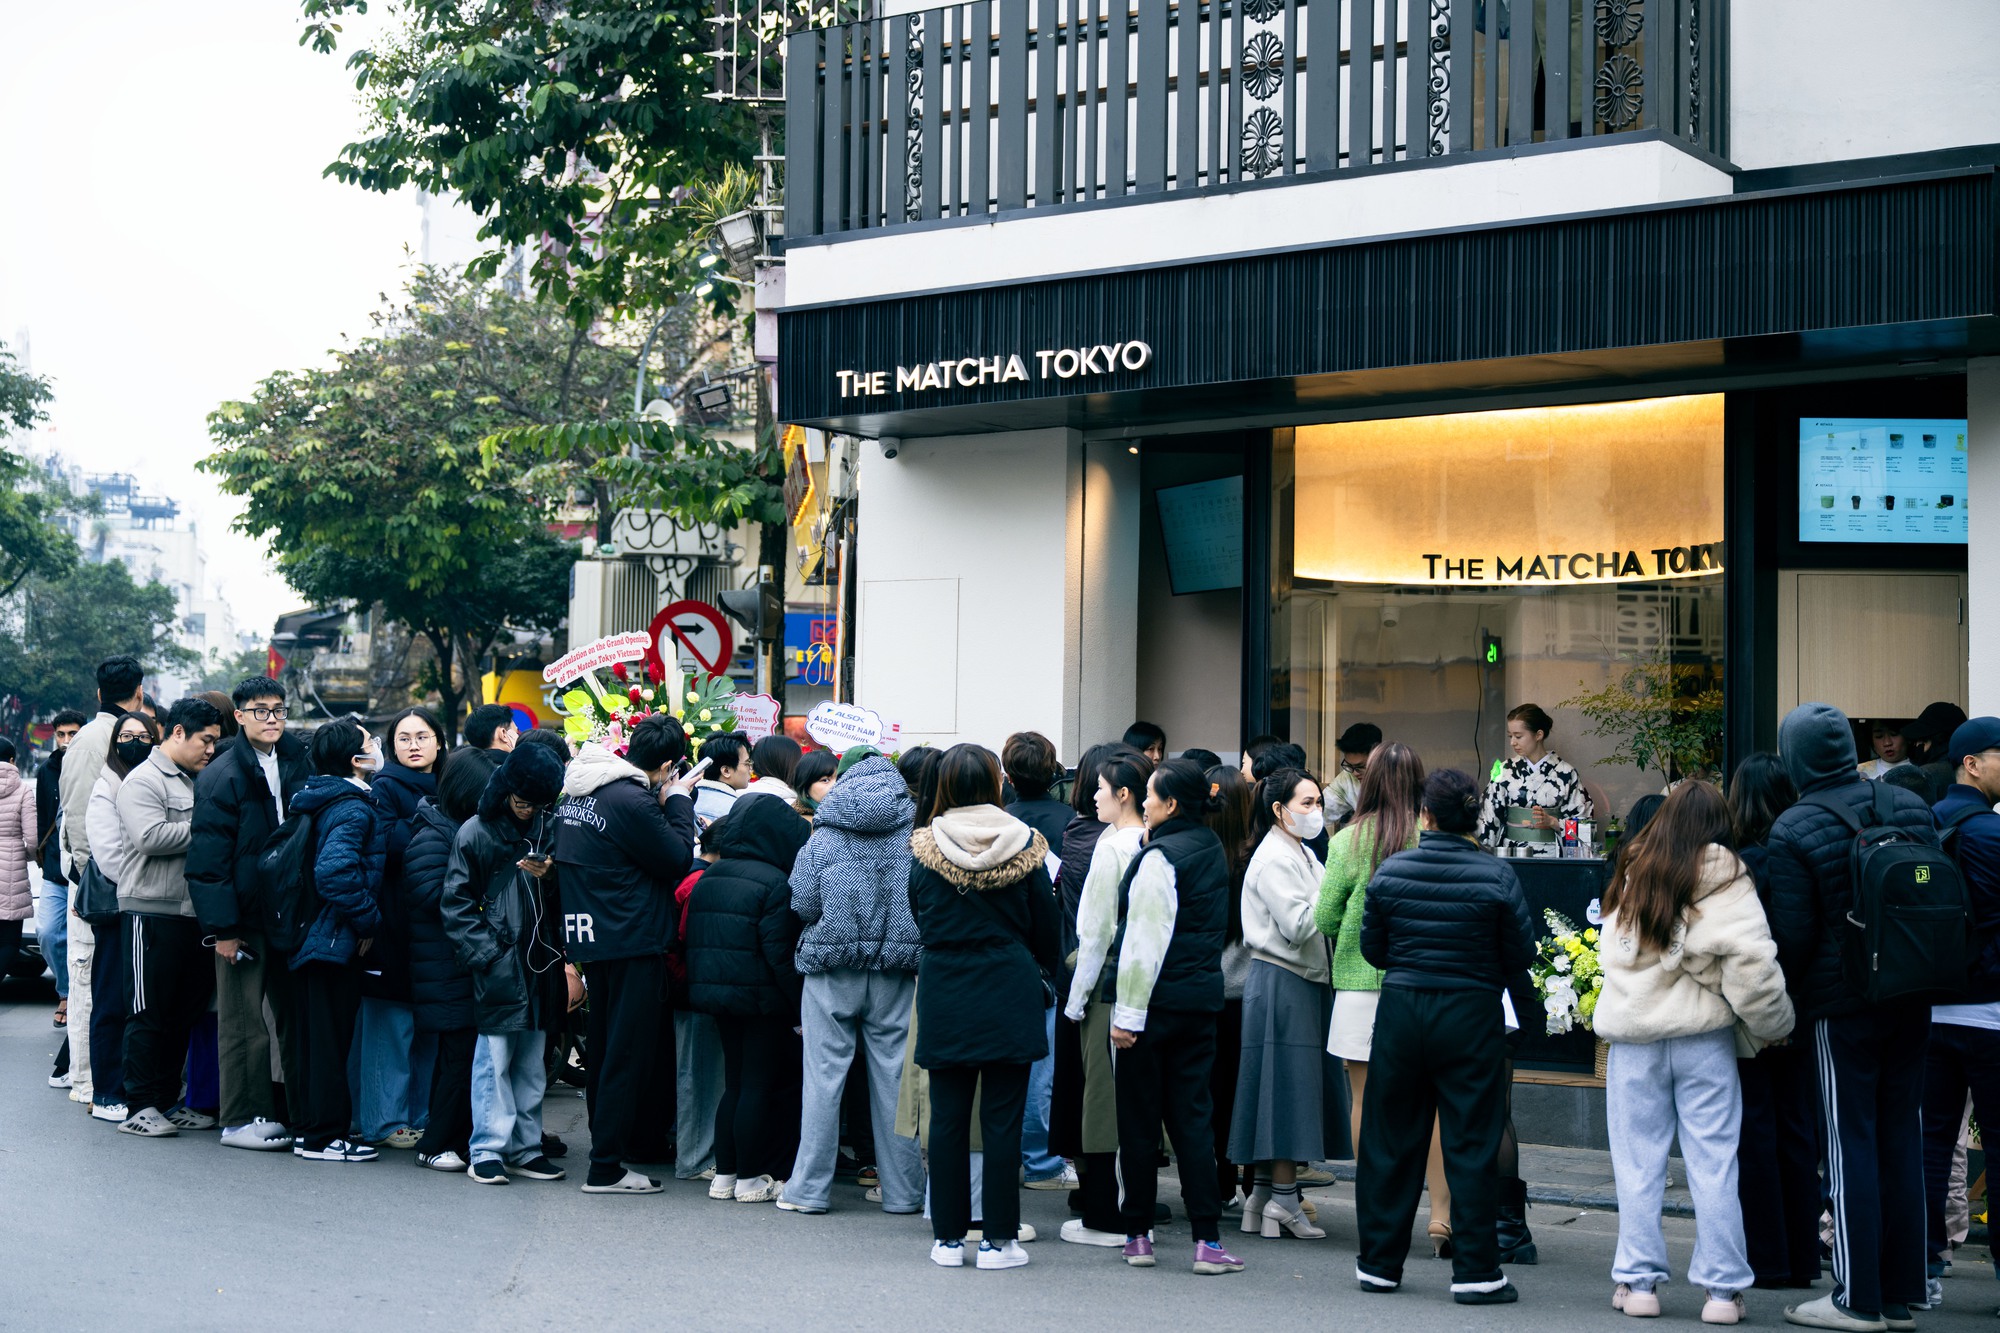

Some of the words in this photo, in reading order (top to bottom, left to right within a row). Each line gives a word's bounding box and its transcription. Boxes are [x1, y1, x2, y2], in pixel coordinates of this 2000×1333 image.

[836, 370, 889, 398] THE
[896, 353, 1030, 393] MATCHA
[1035, 340, 1152, 380] TOKYO
[1422, 554, 1484, 580] THE
[1496, 550, 1645, 581] MATCHA
[546, 649, 588, 678] Congratulation
[588, 647, 596, 655] on
[596, 642, 606, 652] the
[606, 637, 625, 649] Grand
[625, 634, 649, 645] Opening
[559, 673, 566, 684] of
[566, 669, 577, 680] The
[577, 659, 598, 674] Matcha
[598, 654, 617, 666] Tokyo
[616, 648, 641, 658] Vietnam
[737, 714, 768, 725] Wembley
[740, 705, 758, 715] Long
[809, 722, 869, 744] Congratulations
[814, 715, 838, 727] ALSOK
[841, 722, 856, 732] VIET
[857, 726, 876, 737] NAM
[564, 912, 595, 943] FR
